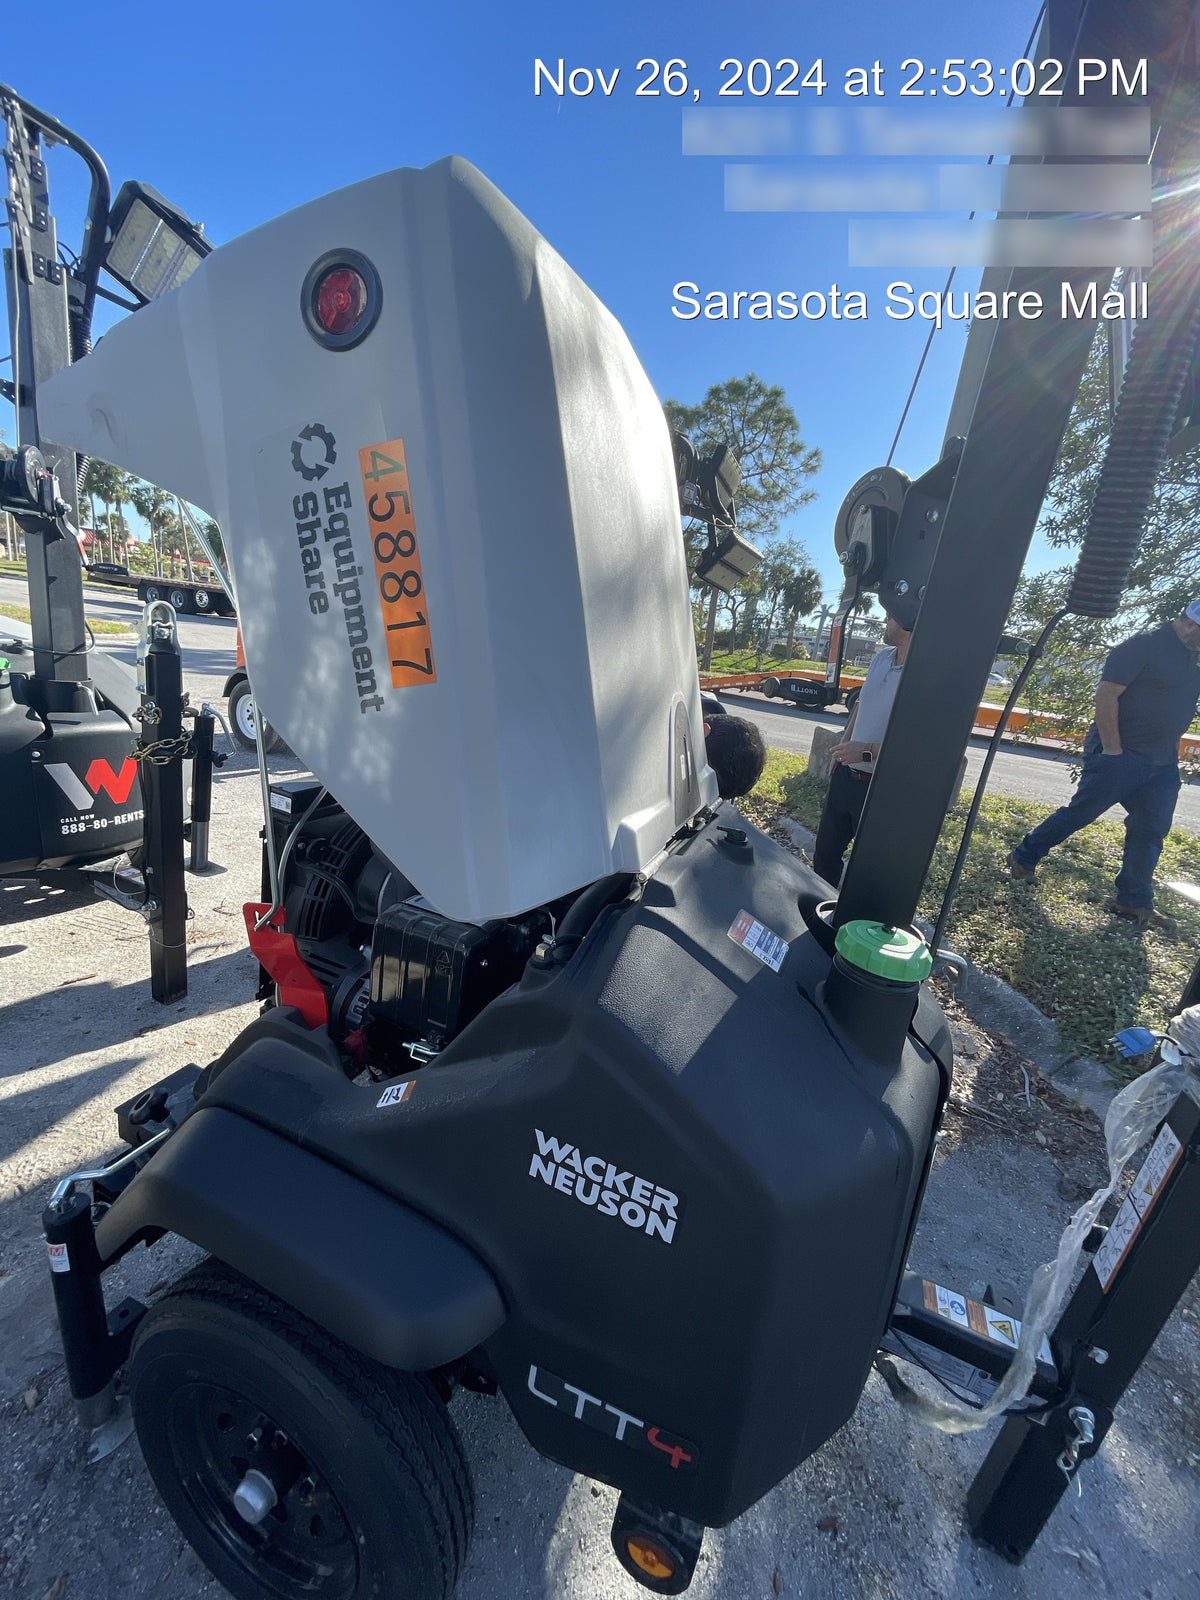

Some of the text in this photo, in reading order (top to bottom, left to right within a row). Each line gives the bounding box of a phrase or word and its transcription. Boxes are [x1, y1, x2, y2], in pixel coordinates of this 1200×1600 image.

[292, 490, 331, 616] Share
[322, 481, 385, 714] Equipment
[364, 449, 434, 676] 458817
[60, 813, 95, 824] CALL NOW
[61, 809, 145, 835] 888-80-RENTS
[527, 1152, 678, 1245] NEUSON
[533, 1127, 680, 1220] WACKER
